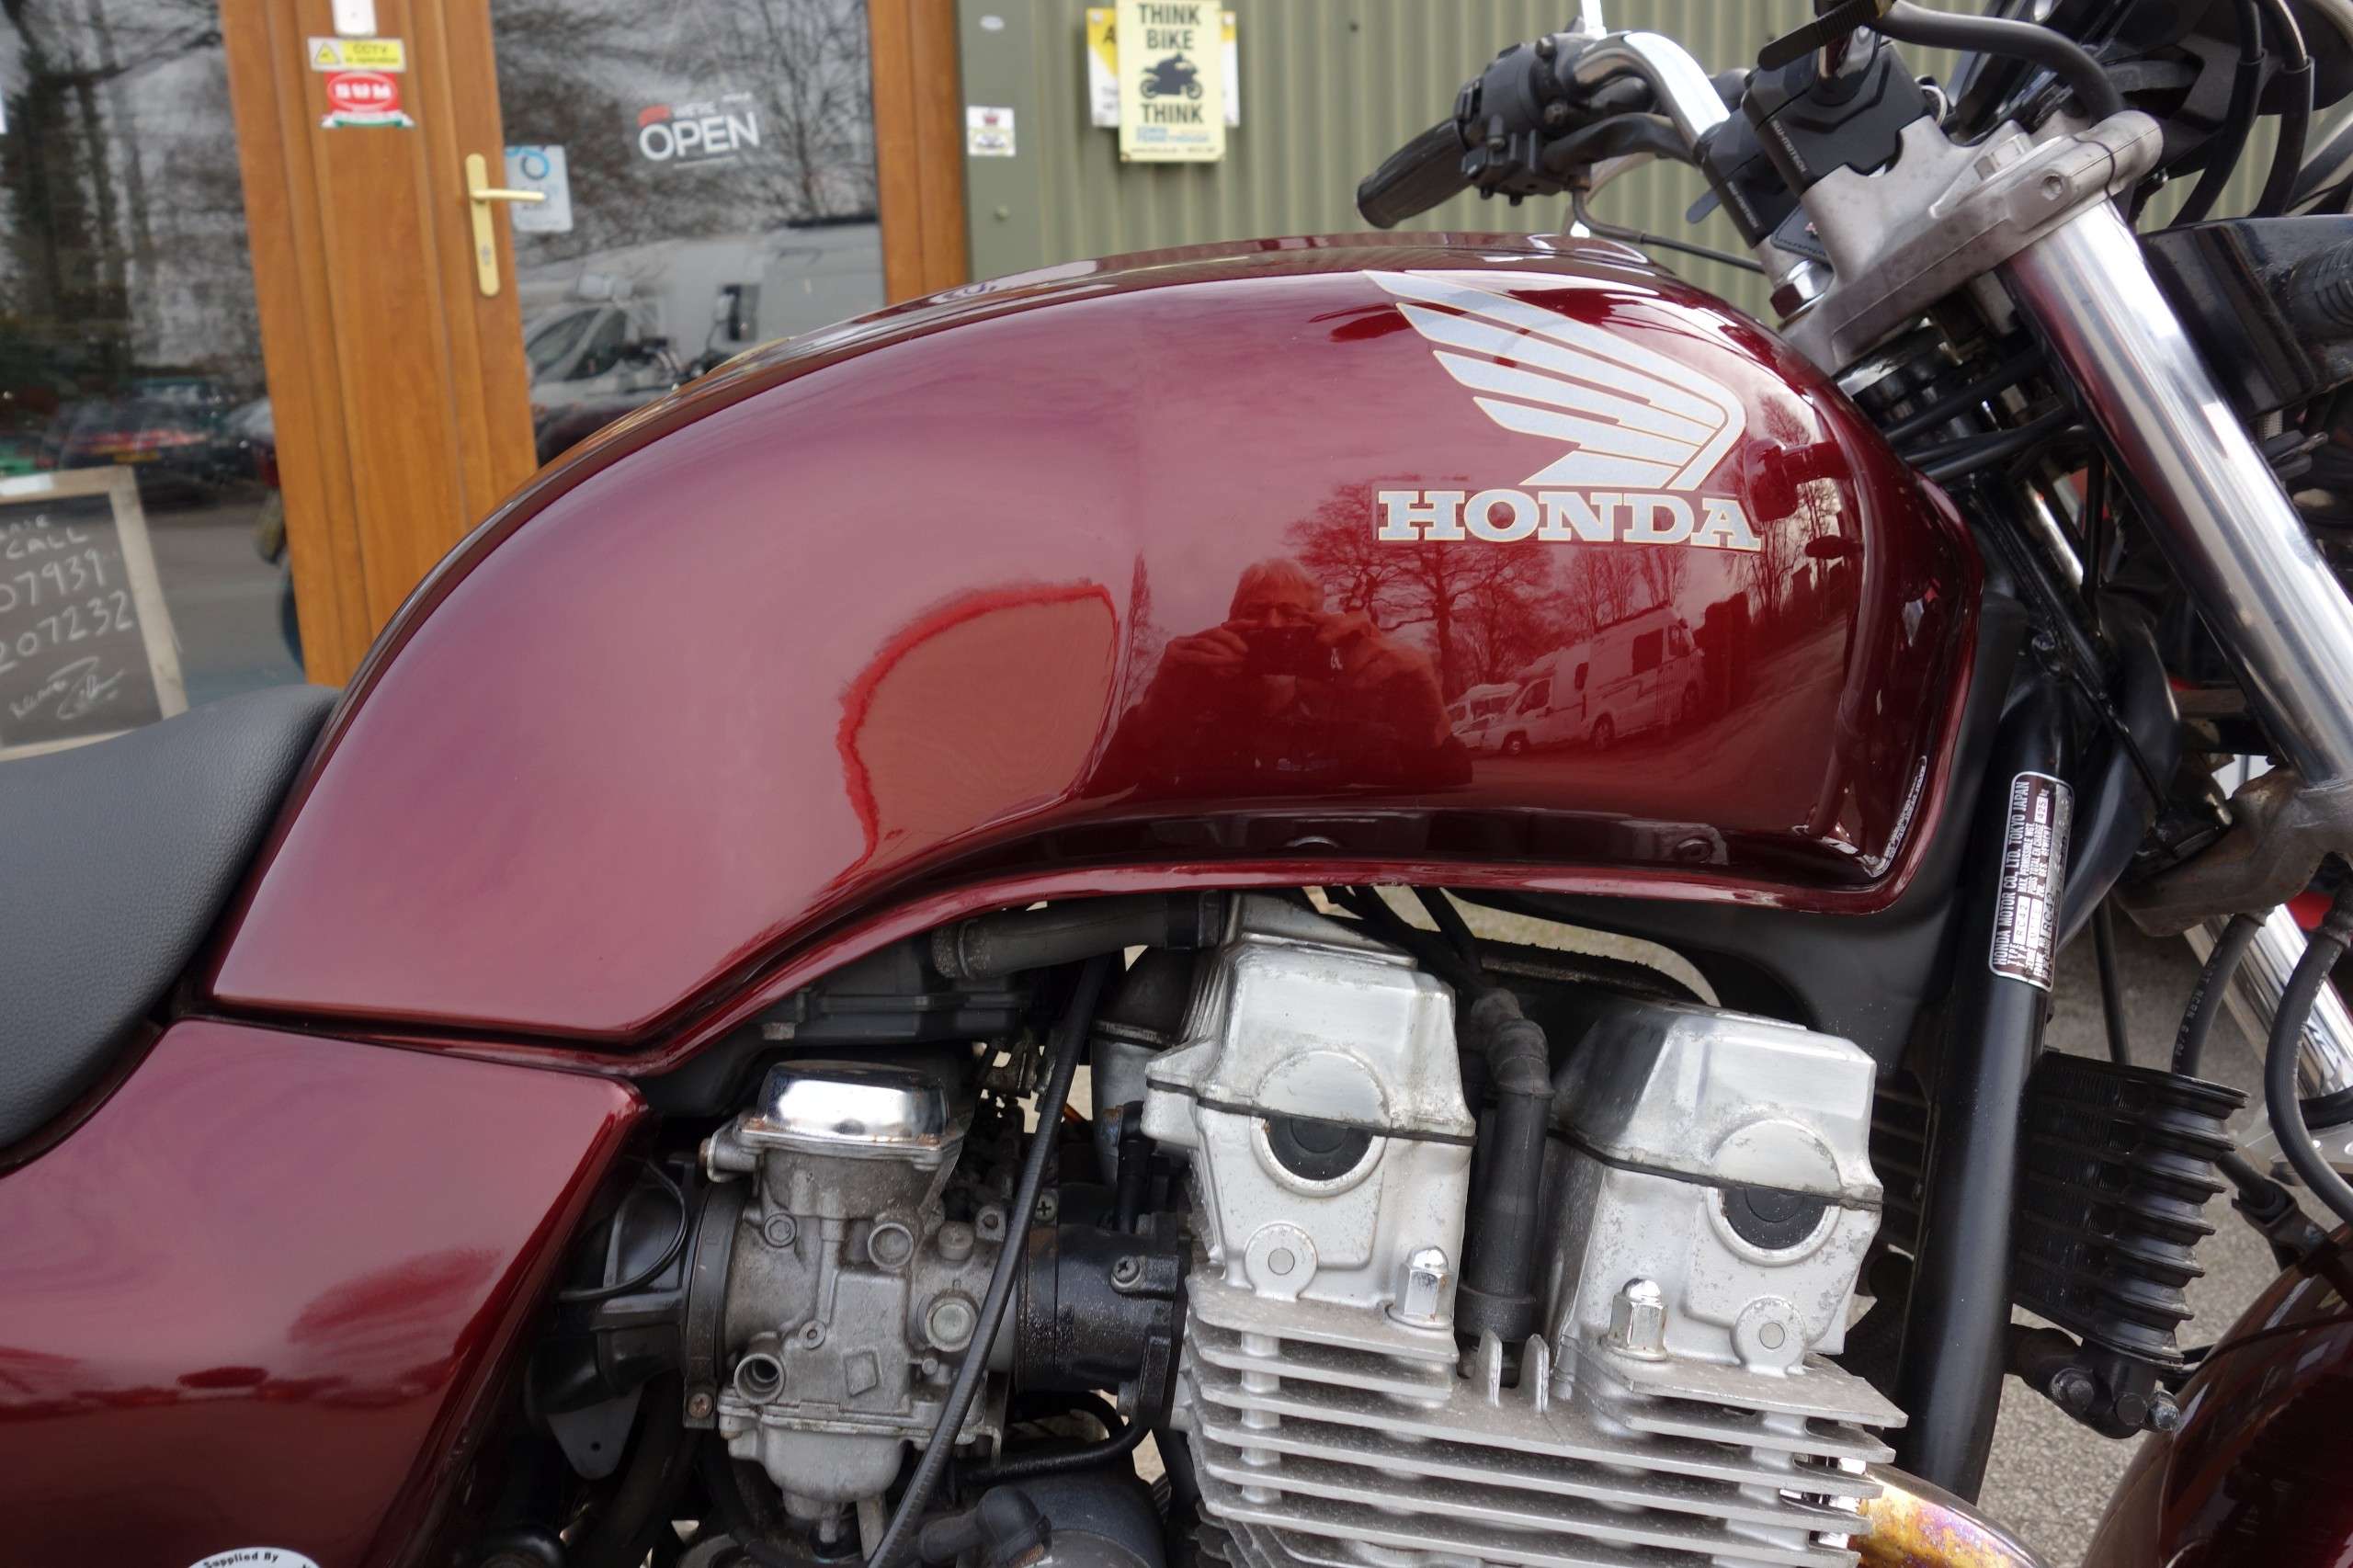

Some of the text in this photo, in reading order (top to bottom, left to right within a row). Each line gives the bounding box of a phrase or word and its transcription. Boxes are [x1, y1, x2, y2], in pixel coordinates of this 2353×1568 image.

[1137, 4, 1201, 26] THINK
[1146, 29, 1194, 50] BIKE
[1140, 103, 1203, 124] THINK
[639, 111, 761, 162] OPEN
[1378, 488, 1762, 551] HONDA
[2013, 781, 2029, 812] JAPAN
[2008, 813, 2026, 845] TOKYO
[2006, 848, 2021, 869] LTD.
[1998, 892, 2017, 926] MOTOR
[1993, 930, 2012, 965] HONDA
